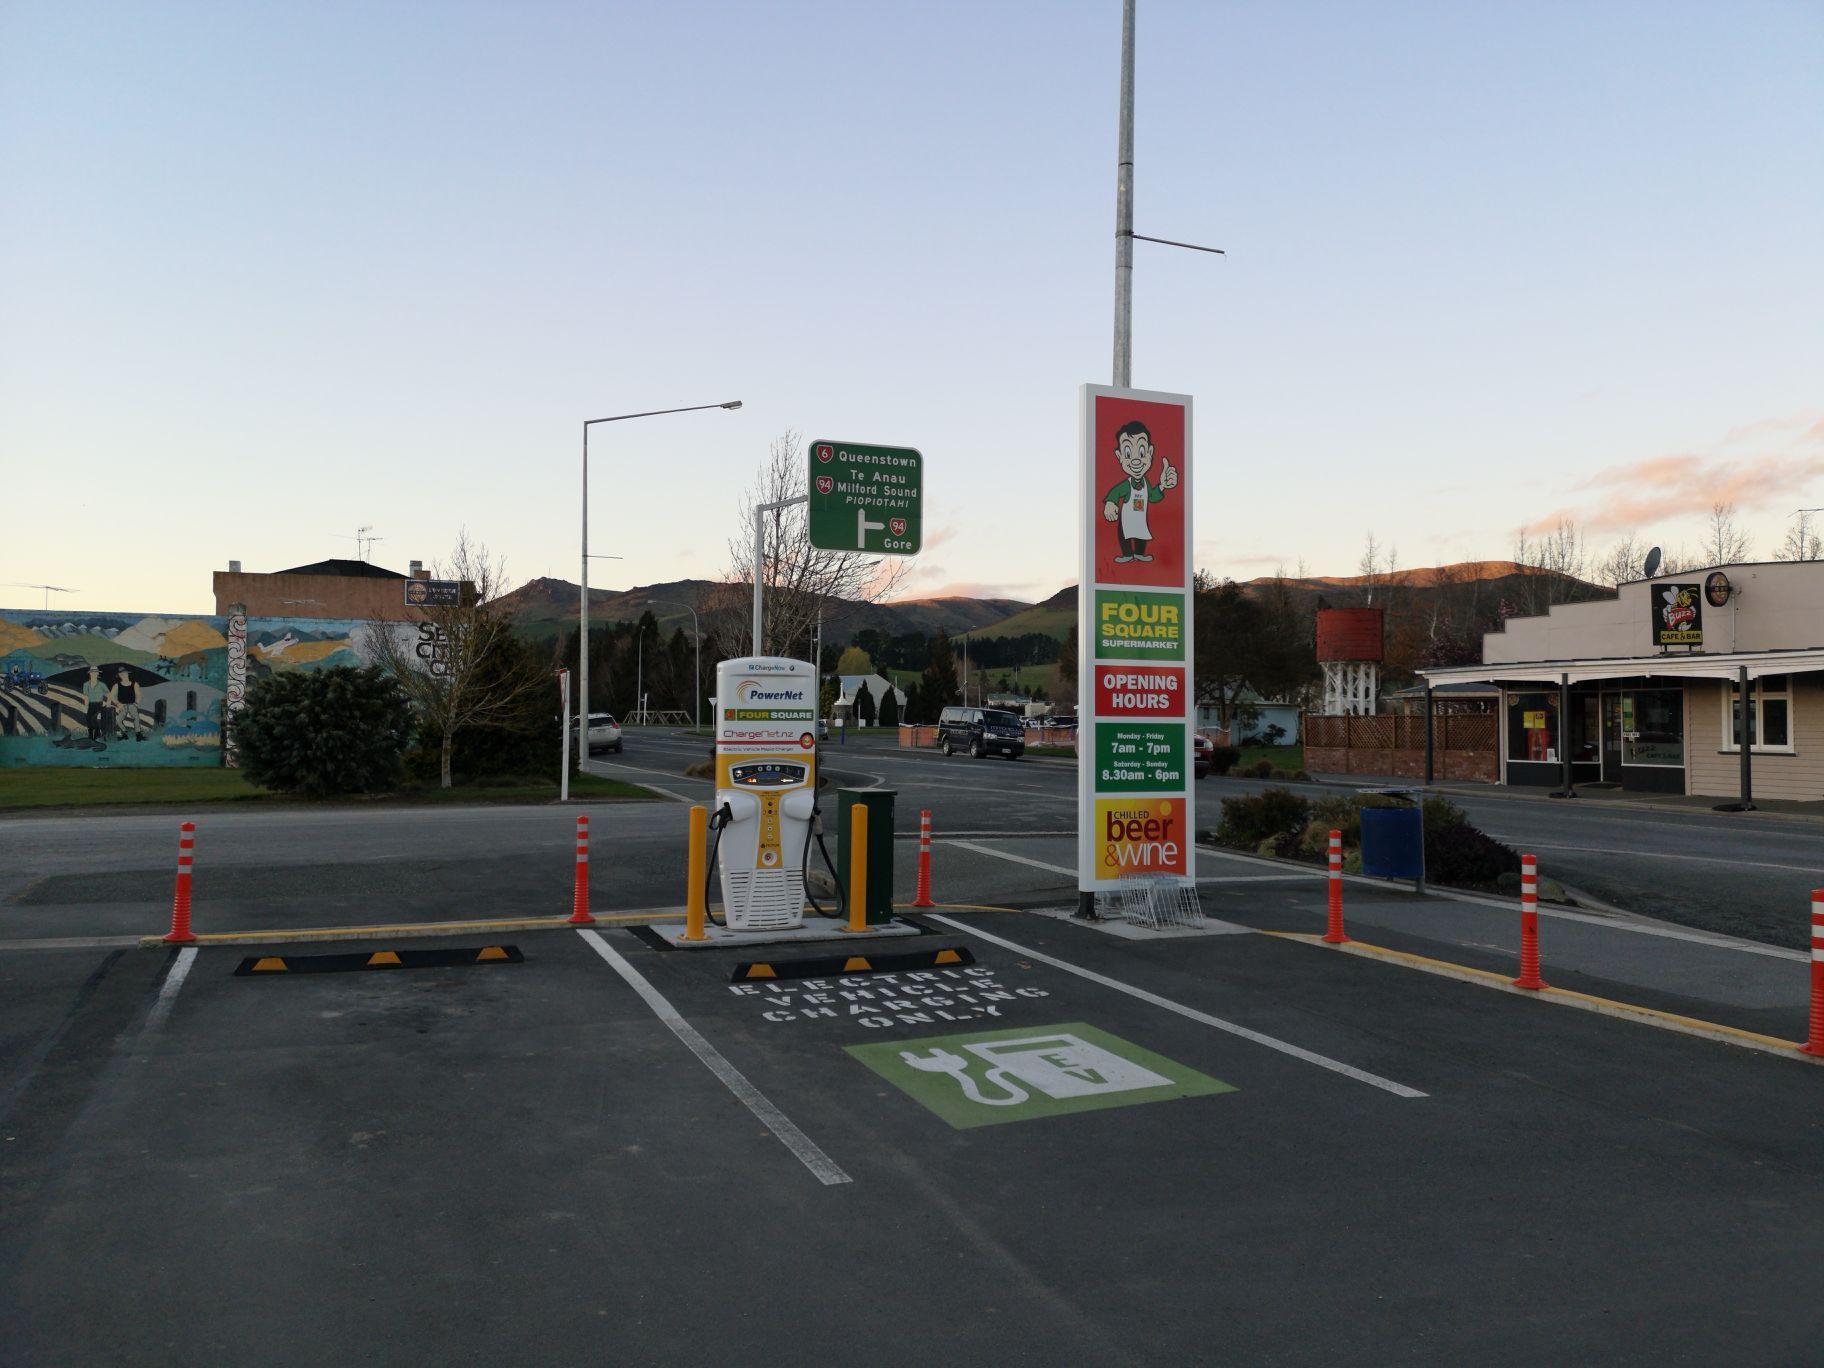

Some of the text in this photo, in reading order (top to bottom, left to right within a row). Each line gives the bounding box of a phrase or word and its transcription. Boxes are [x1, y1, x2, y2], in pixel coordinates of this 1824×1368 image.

[821, 449, 828, 459] 6
[839, 451, 916, 467] Queenstown
[850, 469, 906, 484] Te Anau
[819, 479, 831, 490] 94
[837, 482, 917, 498] Milford Sound
[846, 496, 909, 508] PIOPIOTAHI
[892, 521, 904, 532] 94
[884, 538, 912, 550] Gore
[1101, 602, 1179, 624] FOUR
[1668, 609, 1692, 626] Buzz
[1101, 623, 1179, 639] SQUARE
[1101, 639, 1179, 650] SUPERMARKET
[1103, 674, 1178, 691] OPENING
[750, 690, 804, 700] PowerNet
[1112, 693, 1170, 709] HOURS
[740, 711, 812, 719] FOUR SQUARE
[1117, 732, 1141, 741] Monday
[1146, 732, 1165, 741] Friday
[1111, 742, 1137, 754] 7am
[1147, 742, 1171, 756] 7pm
[1113, 760, 1142, 769] Saturday
[1146, 760, 1168, 769] Sunday
[1102, 769, 1145, 781] 8.30am
[1155, 769, 1179, 782] 6pm
[1113, 810, 1150, 819] CHILLED
[1106, 811, 1174, 842] beer
[728, 967, 995, 996] ELECTRIC
[764, 979, 1003, 1007] VEHICLE
[762, 988, 1050, 1022] CHARGING
[858, 1004, 1002, 1028] ONLY
[1038, 1053, 1109, 1085] EV
